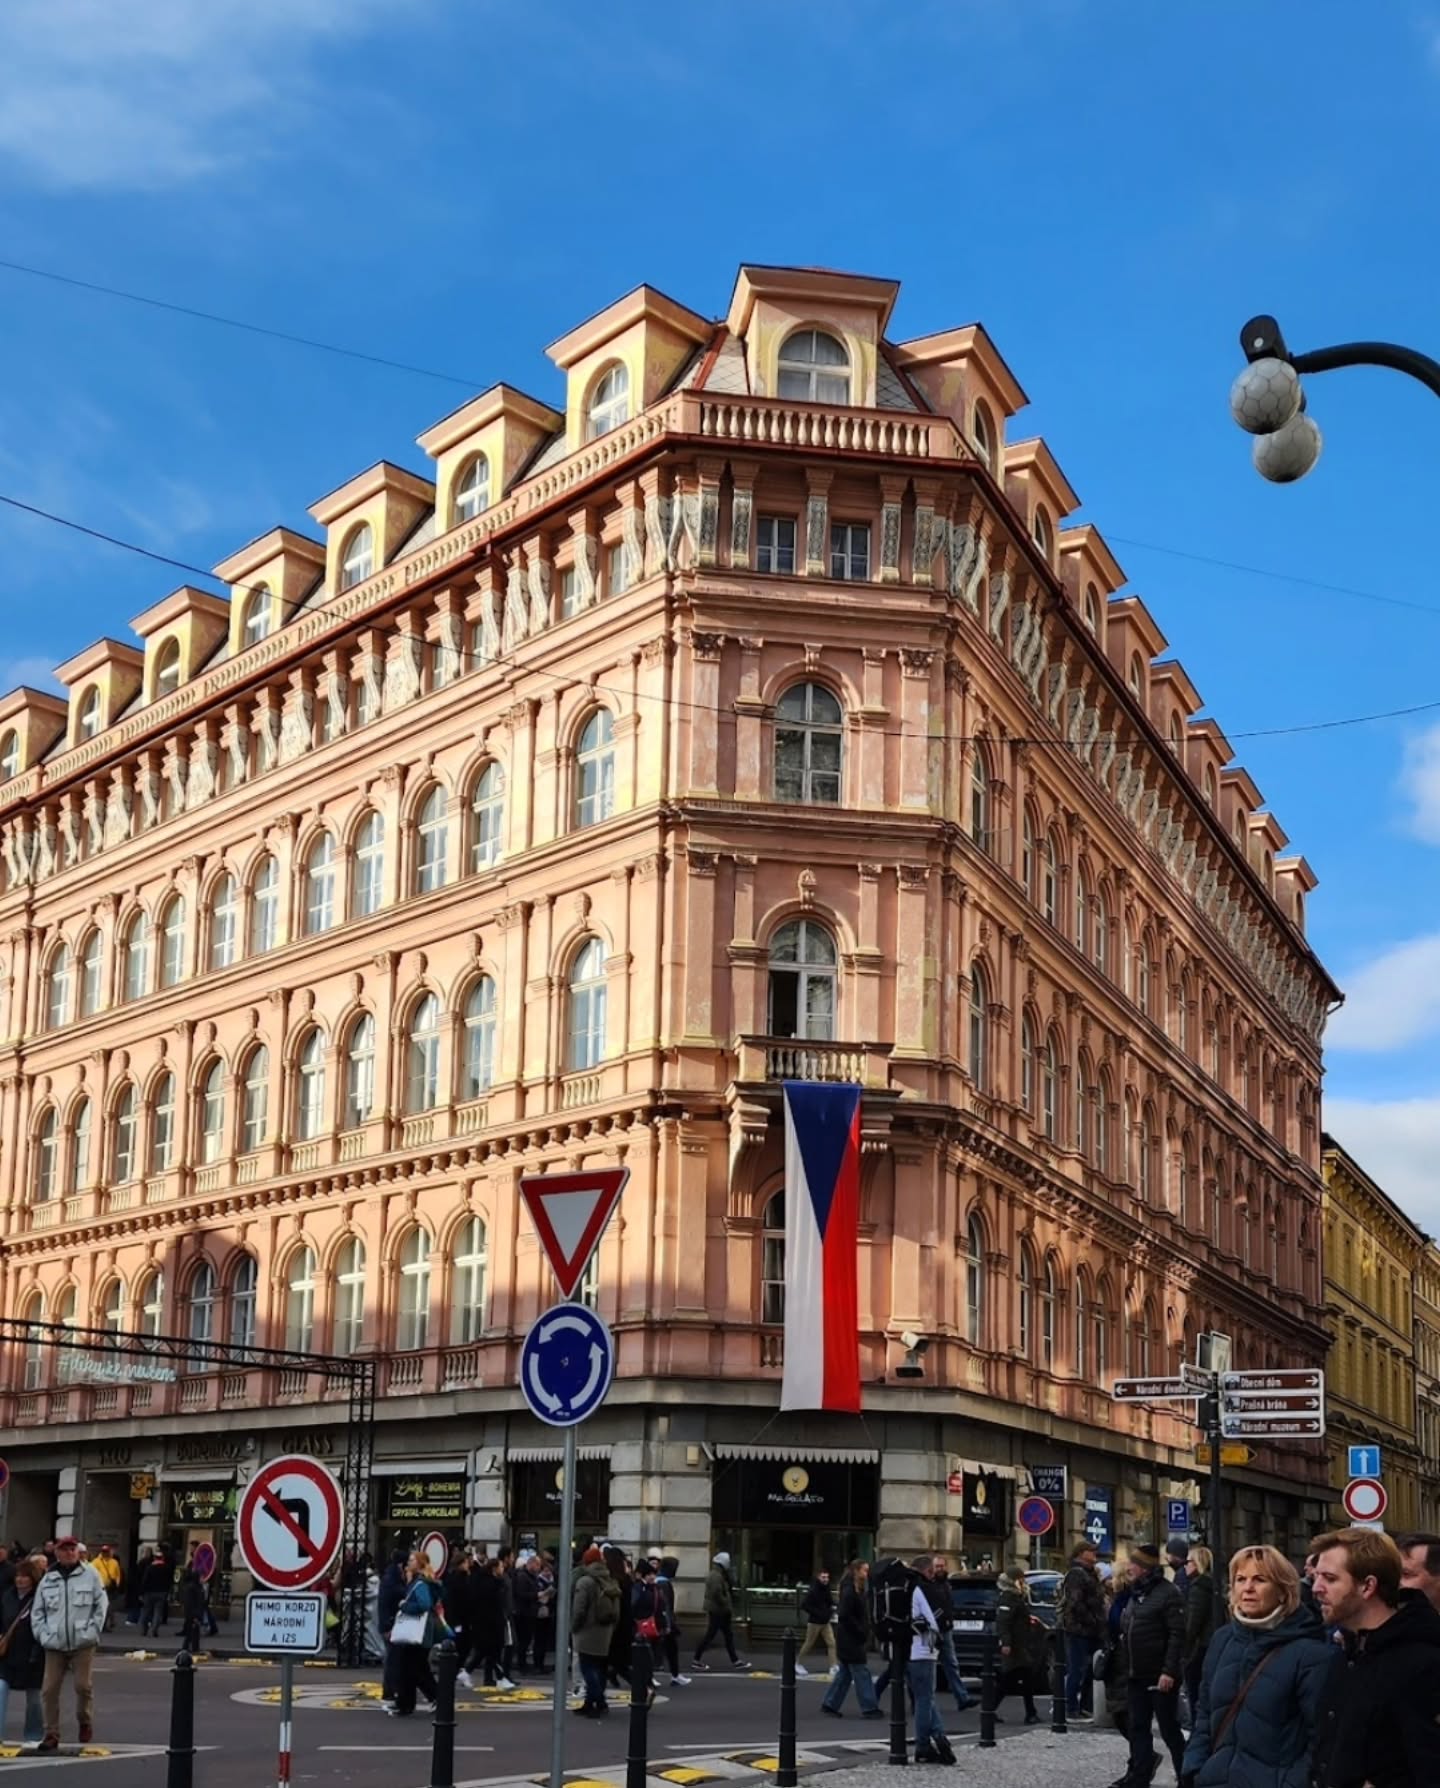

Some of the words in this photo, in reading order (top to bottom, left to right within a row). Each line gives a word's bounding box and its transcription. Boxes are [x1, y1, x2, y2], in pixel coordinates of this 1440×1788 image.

[1038, 1477, 1060, 1491] 0%
[1171, 1502, 1185, 1521] P
[255, 1601, 281, 1612] MIMO
[285, 1602, 316, 1612] KORZO
[263, 1615, 306, 1628] NÁRODNÍ
[271, 1633, 277, 1643] A
[282, 1633, 297, 1643] IZS
